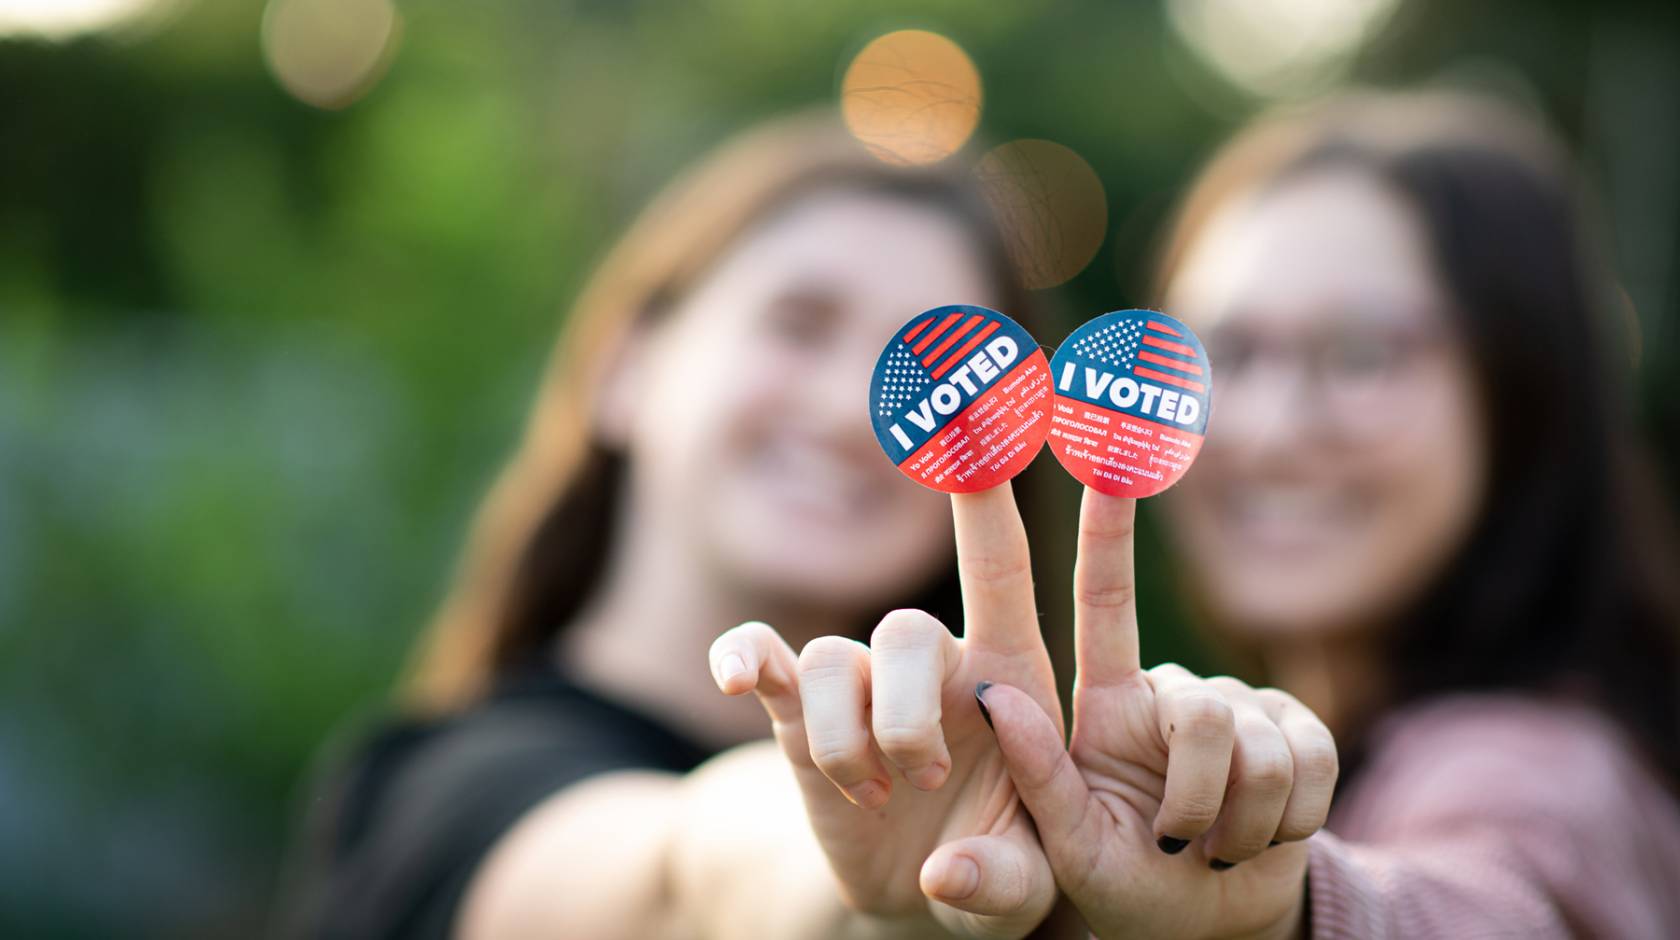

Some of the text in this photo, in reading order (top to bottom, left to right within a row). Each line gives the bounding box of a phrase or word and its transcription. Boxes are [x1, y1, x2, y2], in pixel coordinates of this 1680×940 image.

[889, 424, 914, 451] I
[905, 336, 1018, 433] VOTED
[1059, 362, 1076, 392] I
[1085, 367, 1200, 425] VOTED
[910, 463, 920, 471] Yo
[925, 435, 970, 476] ПРОГОЛОСОВАЛ
